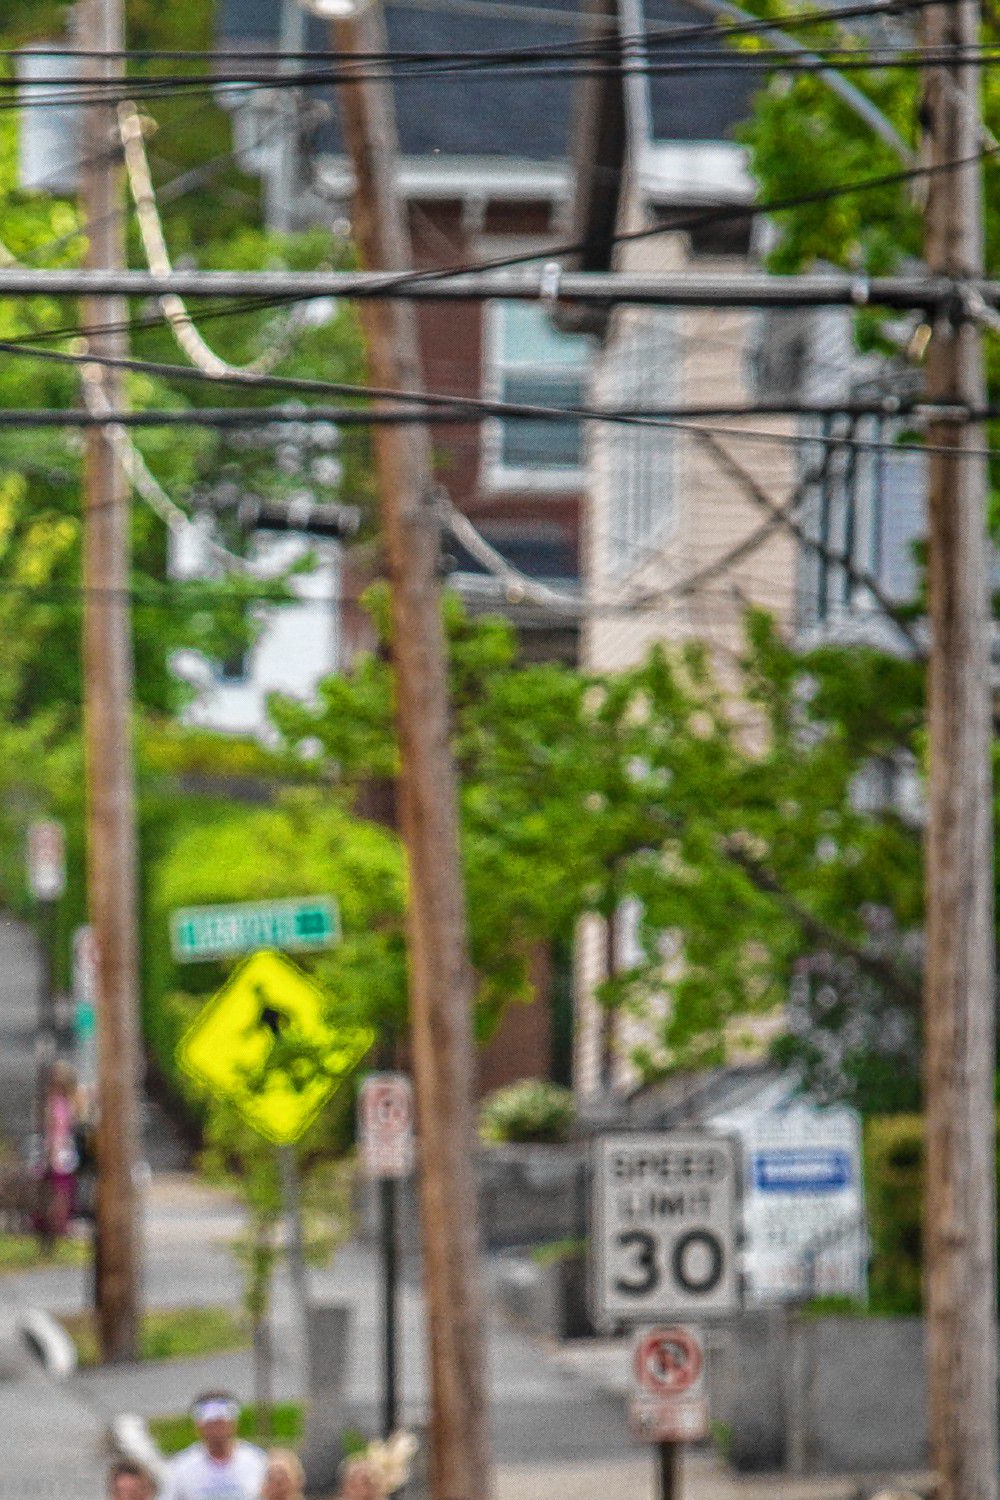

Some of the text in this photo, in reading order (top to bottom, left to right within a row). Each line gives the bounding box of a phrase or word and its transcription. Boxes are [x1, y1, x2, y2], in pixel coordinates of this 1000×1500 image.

[611, 1150, 723, 1180] SPEED
[617, 1190, 712, 1217] LIMIT
[613, 1227, 725, 1296] 30
